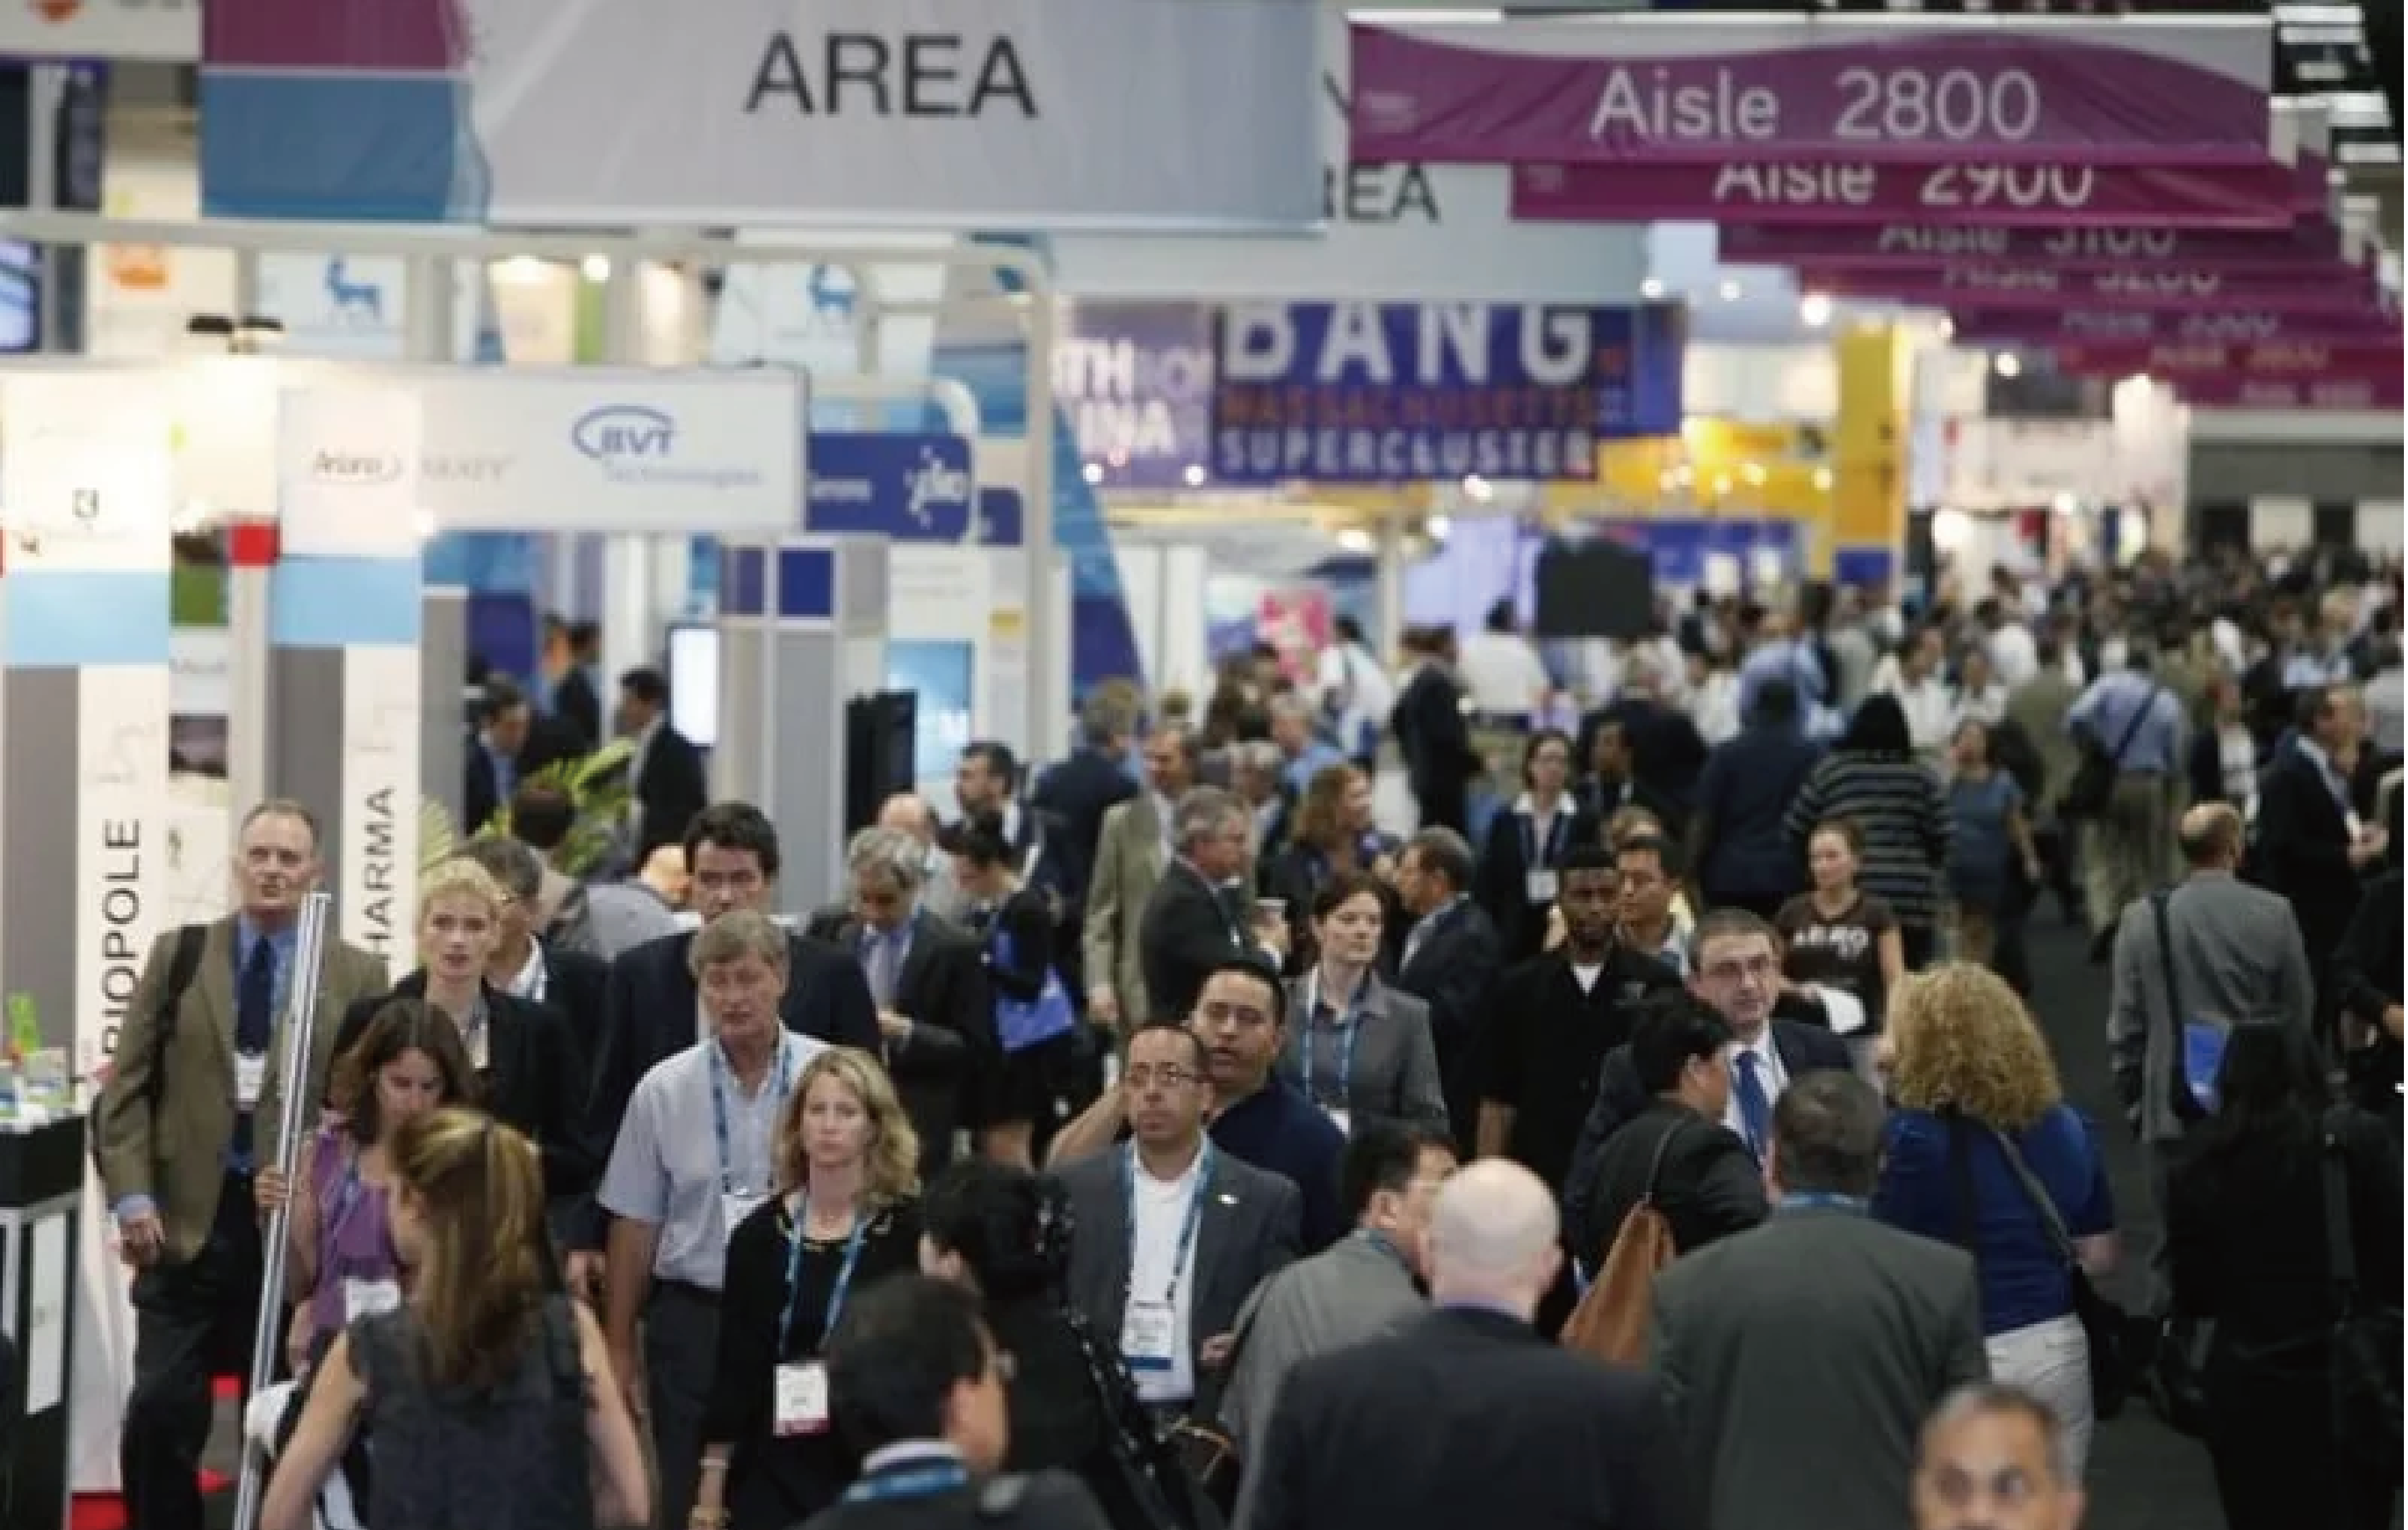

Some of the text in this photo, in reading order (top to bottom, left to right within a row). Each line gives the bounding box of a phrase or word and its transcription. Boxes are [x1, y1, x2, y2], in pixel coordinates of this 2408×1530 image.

[745, 30, 1039, 118] AREA
[1591, 67, 2040, 140] Aisle 2800
[1324, 163, 1439, 223] EA
[1713, 165, 2094, 206] Aisle 2900
[1224, 301, 1592, 385] BANG
[1222, 428, 1593, 476] SUPERCLUSTER
